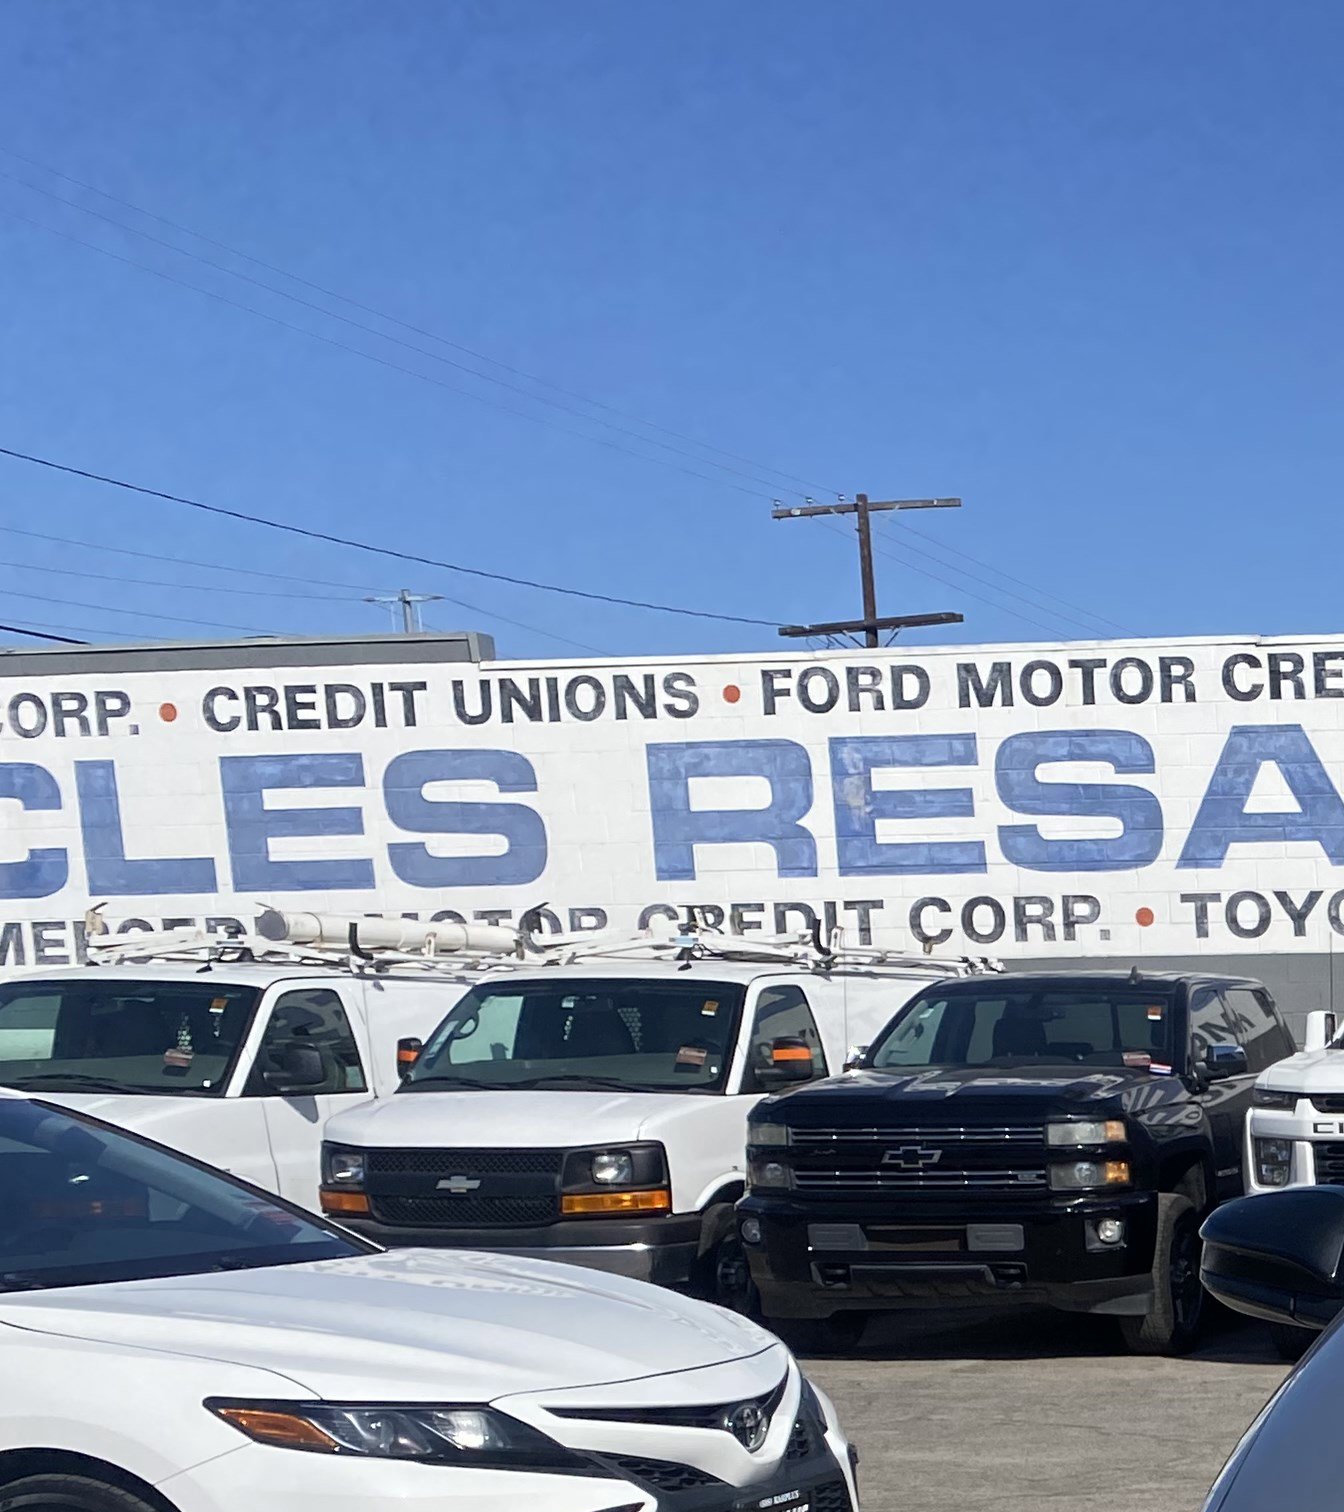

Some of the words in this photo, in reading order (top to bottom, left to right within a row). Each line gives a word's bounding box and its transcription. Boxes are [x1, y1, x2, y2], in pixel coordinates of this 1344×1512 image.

[0, 690, 140, 739] ORP.
[203, 681, 427, 732] CREDIT
[452, 671, 699, 725] UNIONS
[760, 664, 930, 715] FORD
[957, 656, 1196, 708] MOTOR
[909, 895, 1111, 944] CORP.
